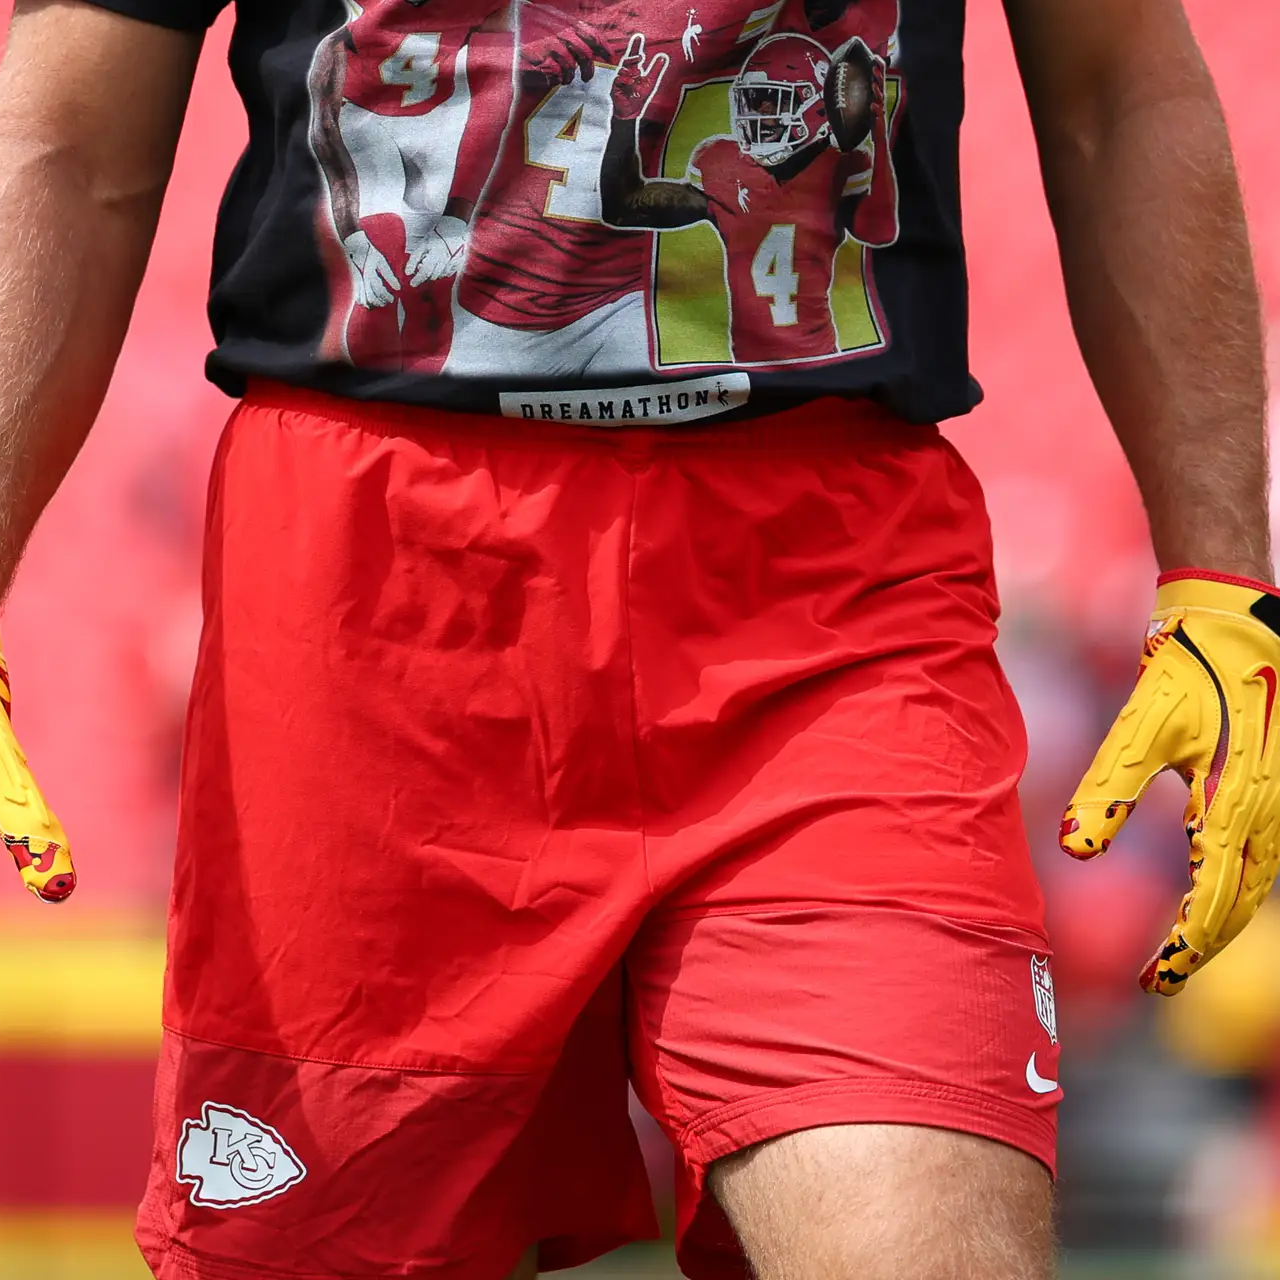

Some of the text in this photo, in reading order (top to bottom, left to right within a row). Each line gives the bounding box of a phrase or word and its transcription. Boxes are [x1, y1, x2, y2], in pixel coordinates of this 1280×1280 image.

[378, 32, 442, 107] 4
[523, 60, 619, 223] 4
[750, 223, 797, 328] 4
[520, 389, 710, 420] DREAMATHON
[209, 1127, 276, 1190] KC
